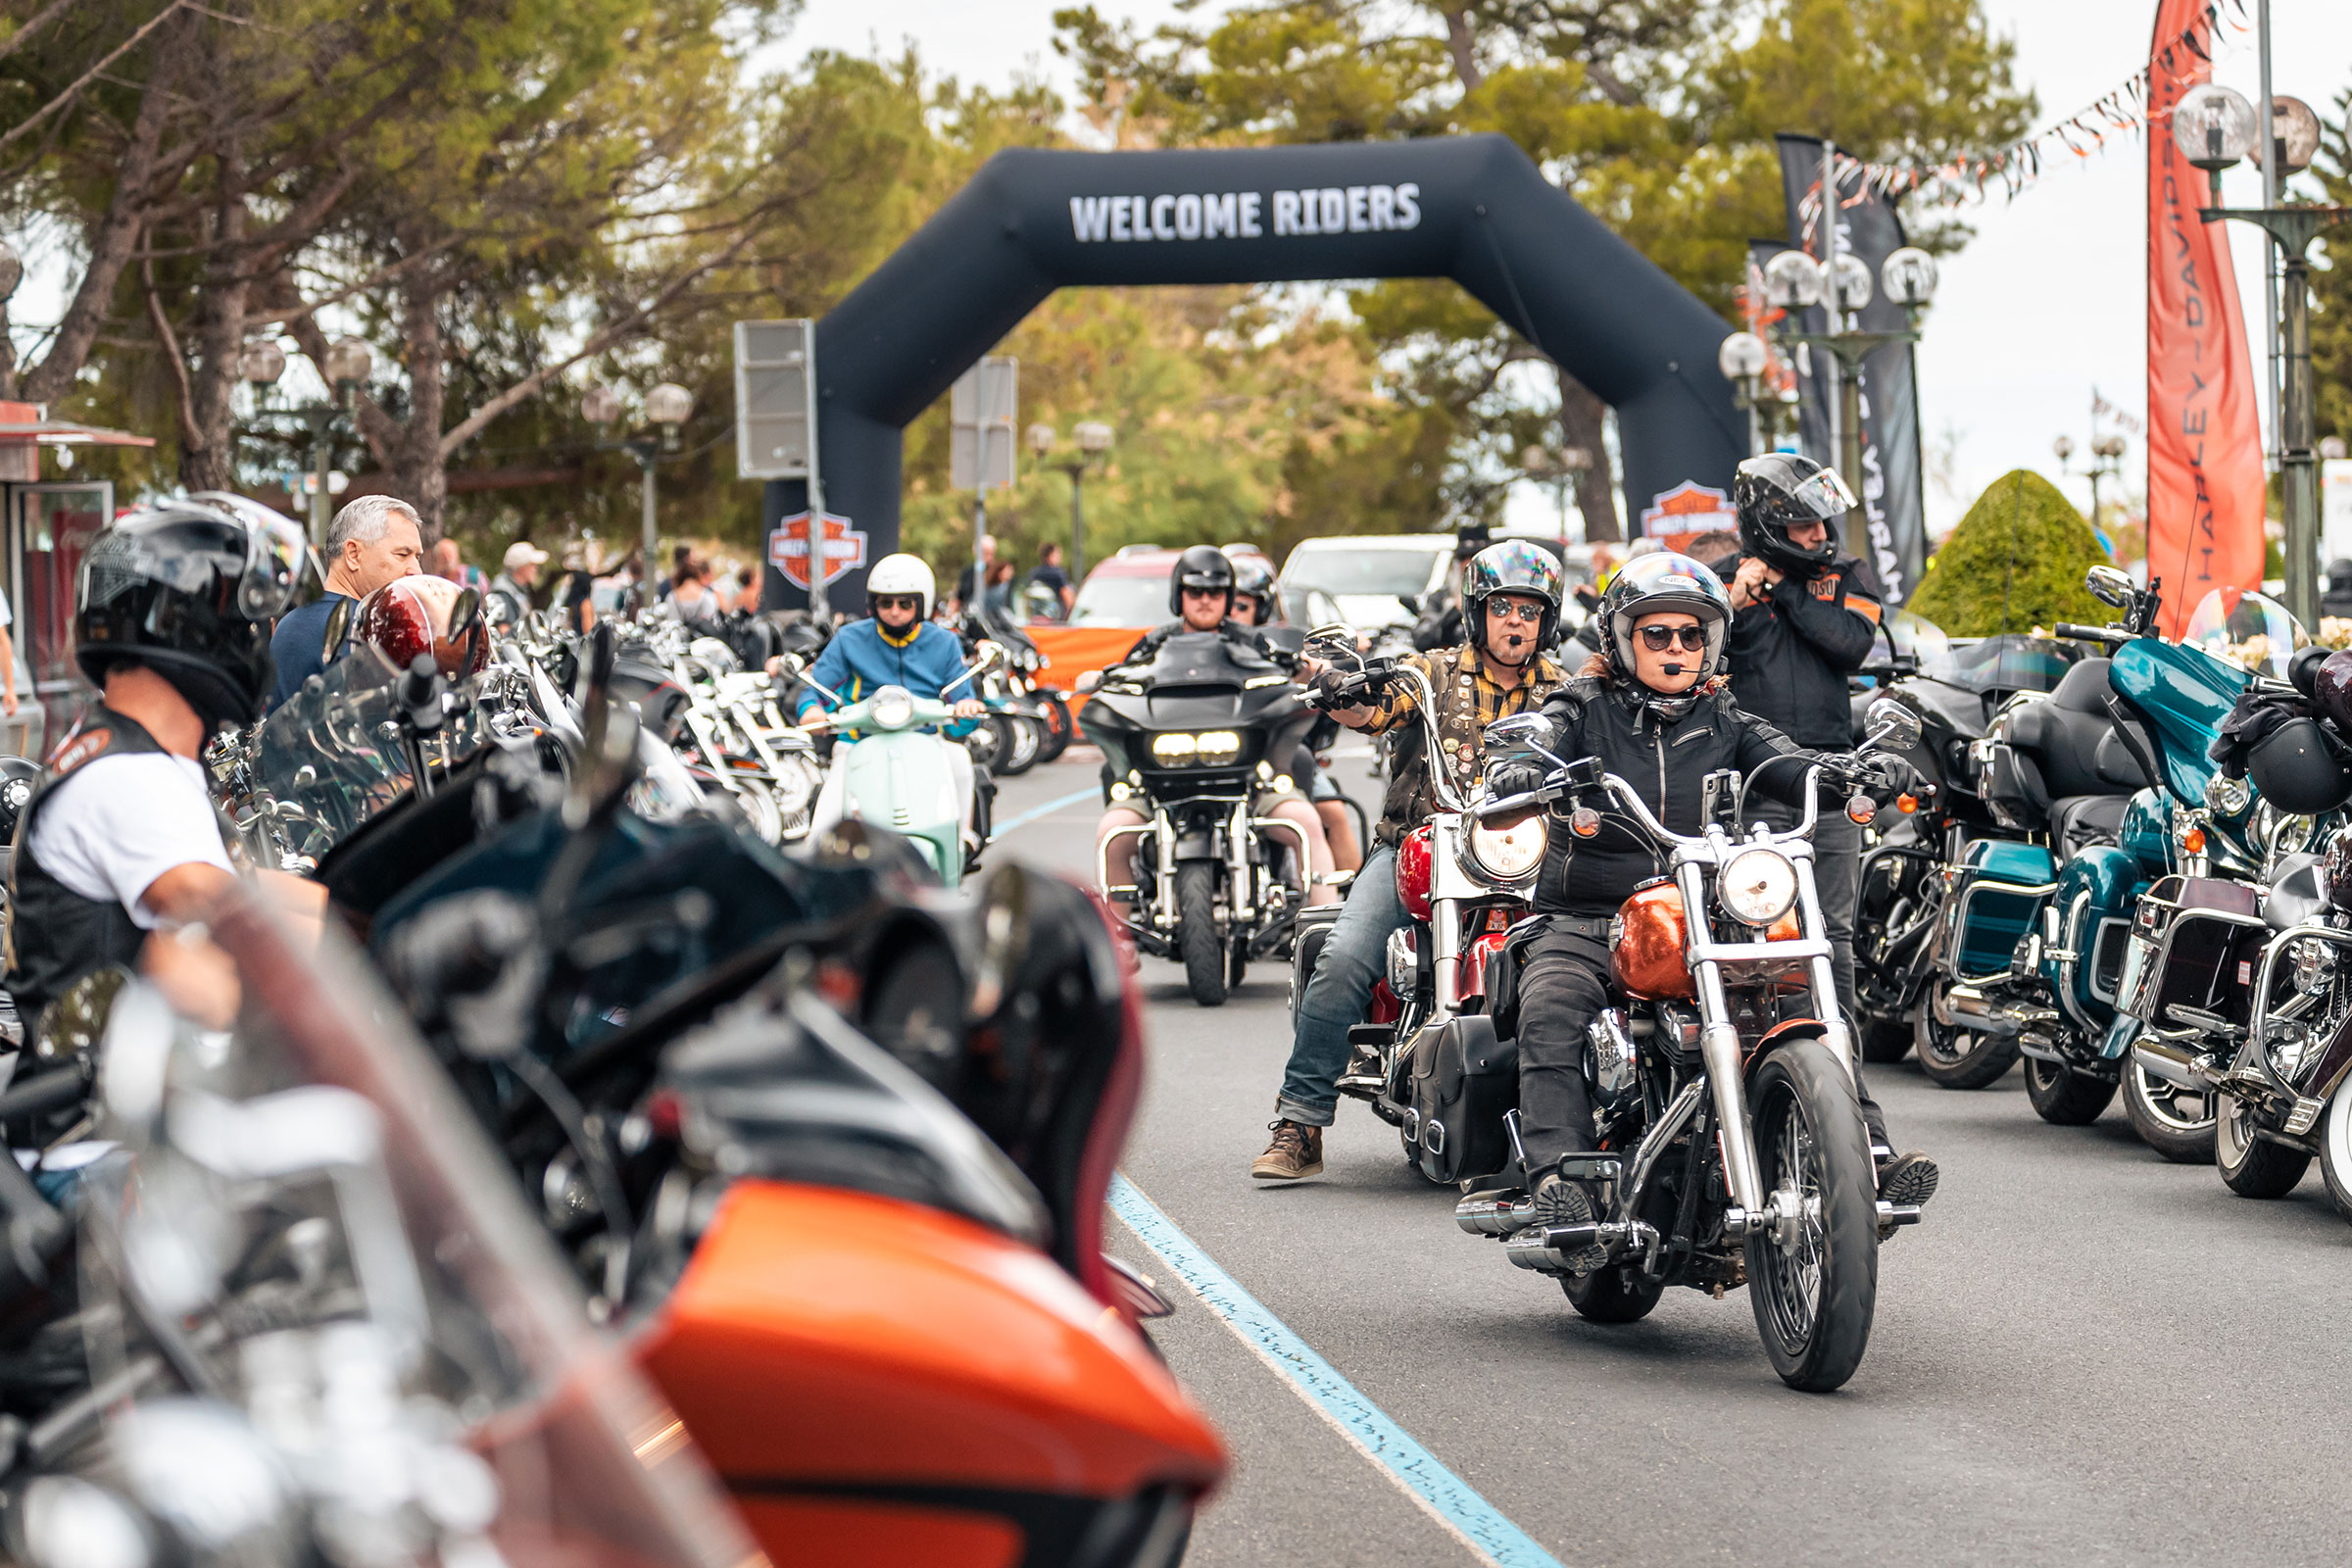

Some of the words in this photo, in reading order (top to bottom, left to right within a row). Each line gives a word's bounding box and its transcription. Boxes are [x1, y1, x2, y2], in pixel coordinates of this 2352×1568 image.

[1069, 192, 1263, 242] WELCOME
[1273, 182, 1421, 236] RIDERS
[2163, 80, 2215, 581] HARLEY-DAVIDS
